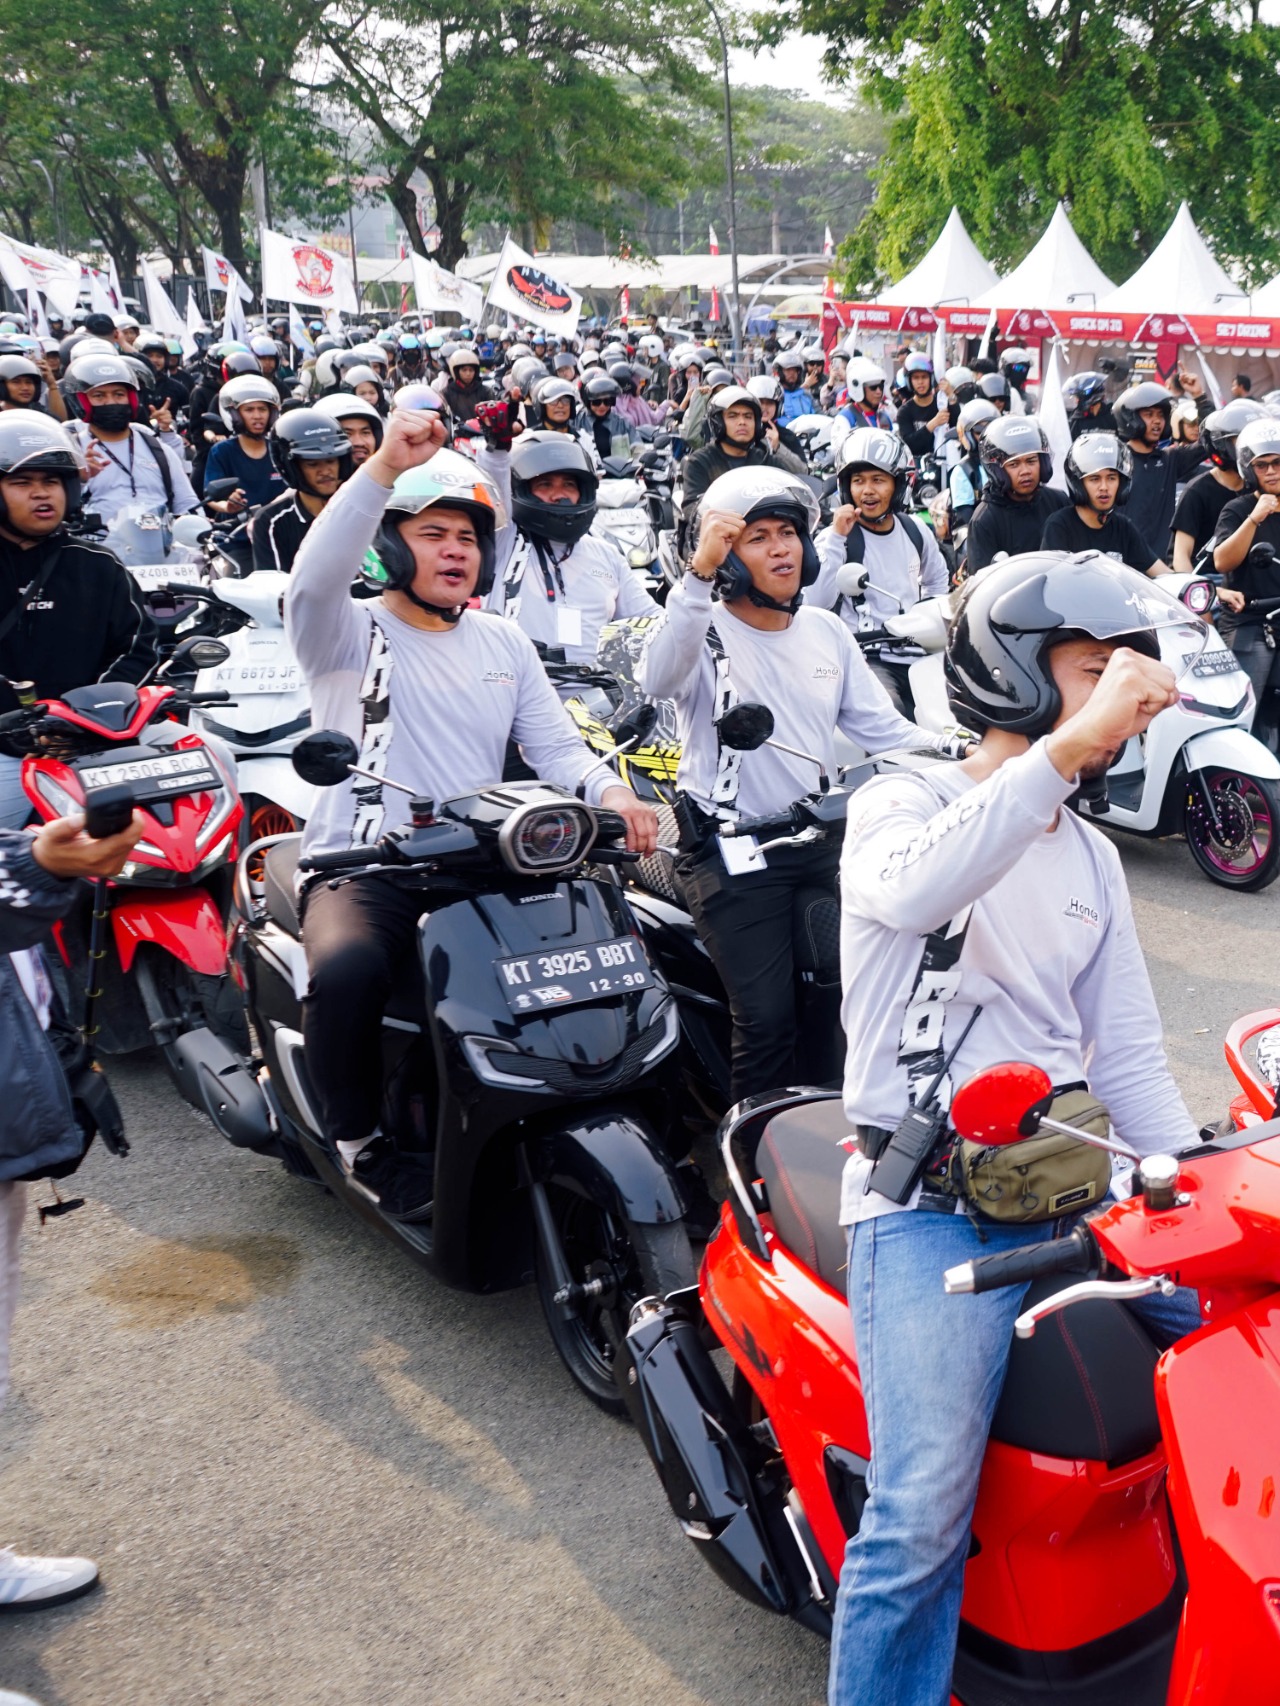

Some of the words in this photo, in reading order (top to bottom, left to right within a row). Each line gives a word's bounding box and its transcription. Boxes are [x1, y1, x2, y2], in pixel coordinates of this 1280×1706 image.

[216, 668, 235, 681] KT
[280, 666, 297, 679] JF
[86, 769, 112, 788] KT
[117, 762, 164, 782] 2506
[170, 755, 205, 772] BCJ
[519, 892, 565, 904] HONDA
[501, 960, 532, 985] KT
[537, 950, 592, 978] 3925
[596, 941, 636, 968] BBT
